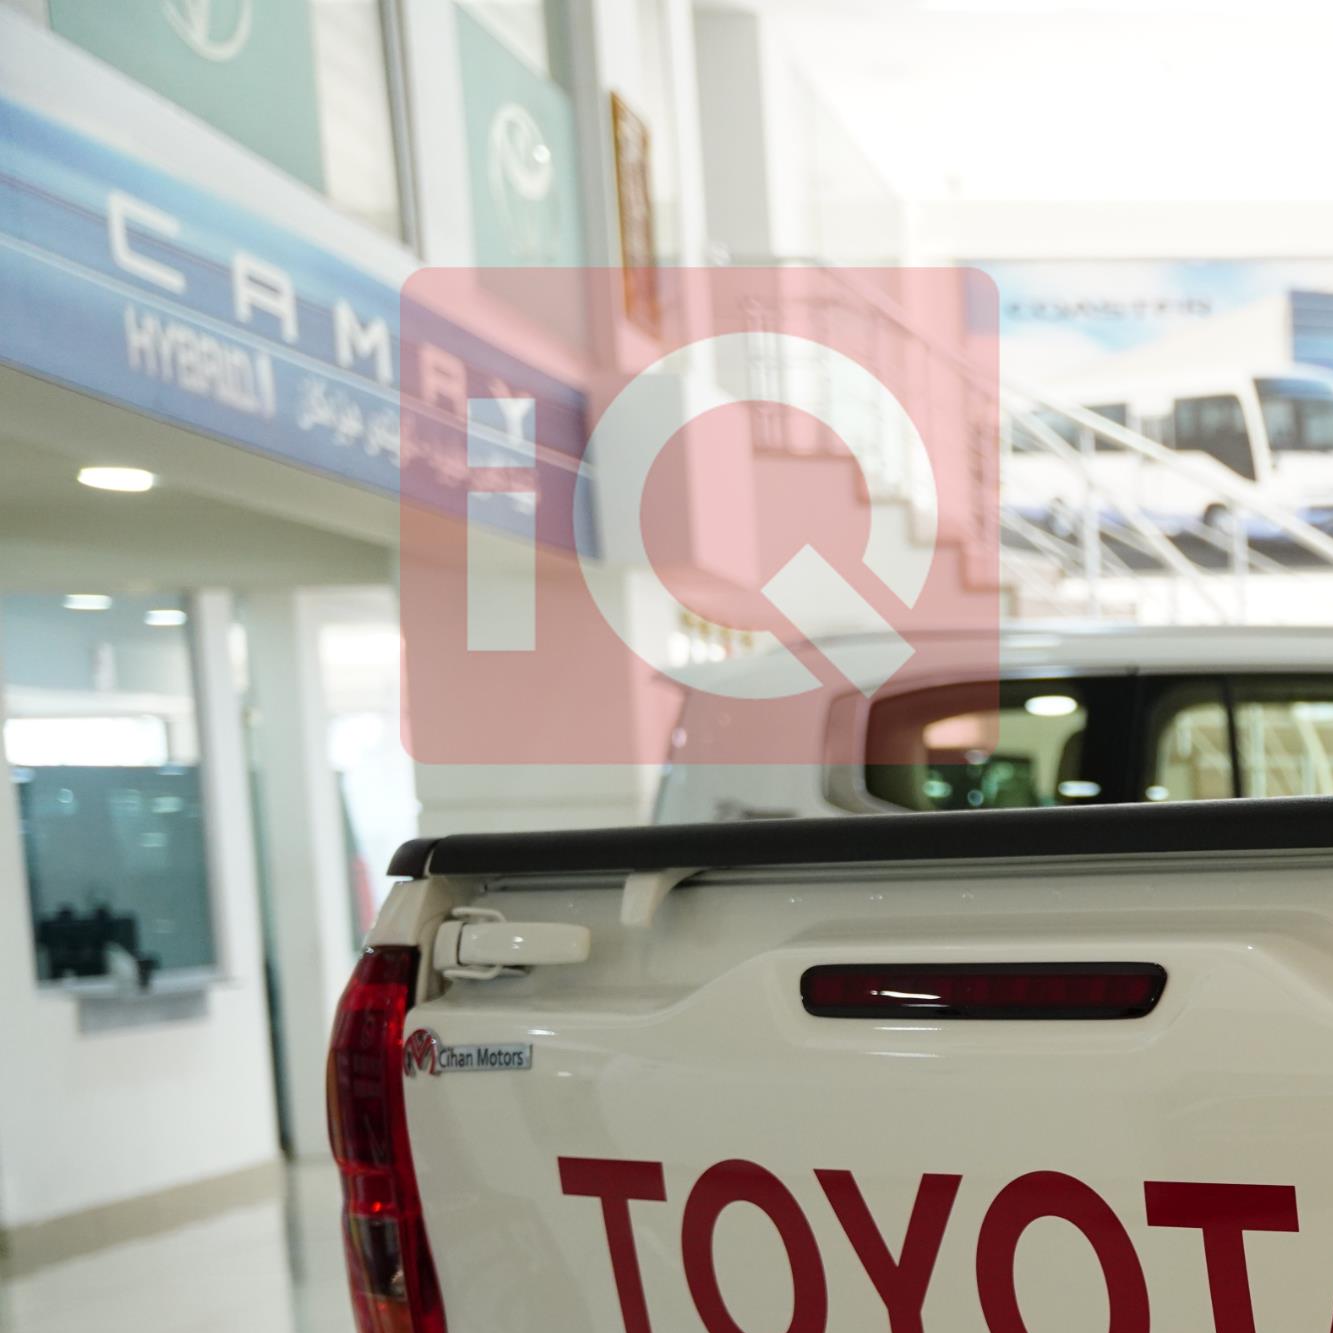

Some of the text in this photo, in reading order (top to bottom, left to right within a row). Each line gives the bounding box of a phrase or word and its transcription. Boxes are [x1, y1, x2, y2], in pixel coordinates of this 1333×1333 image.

[109, 190, 536, 446] CAMRY
[439, 1046, 525, 1069] Cihan Motors
